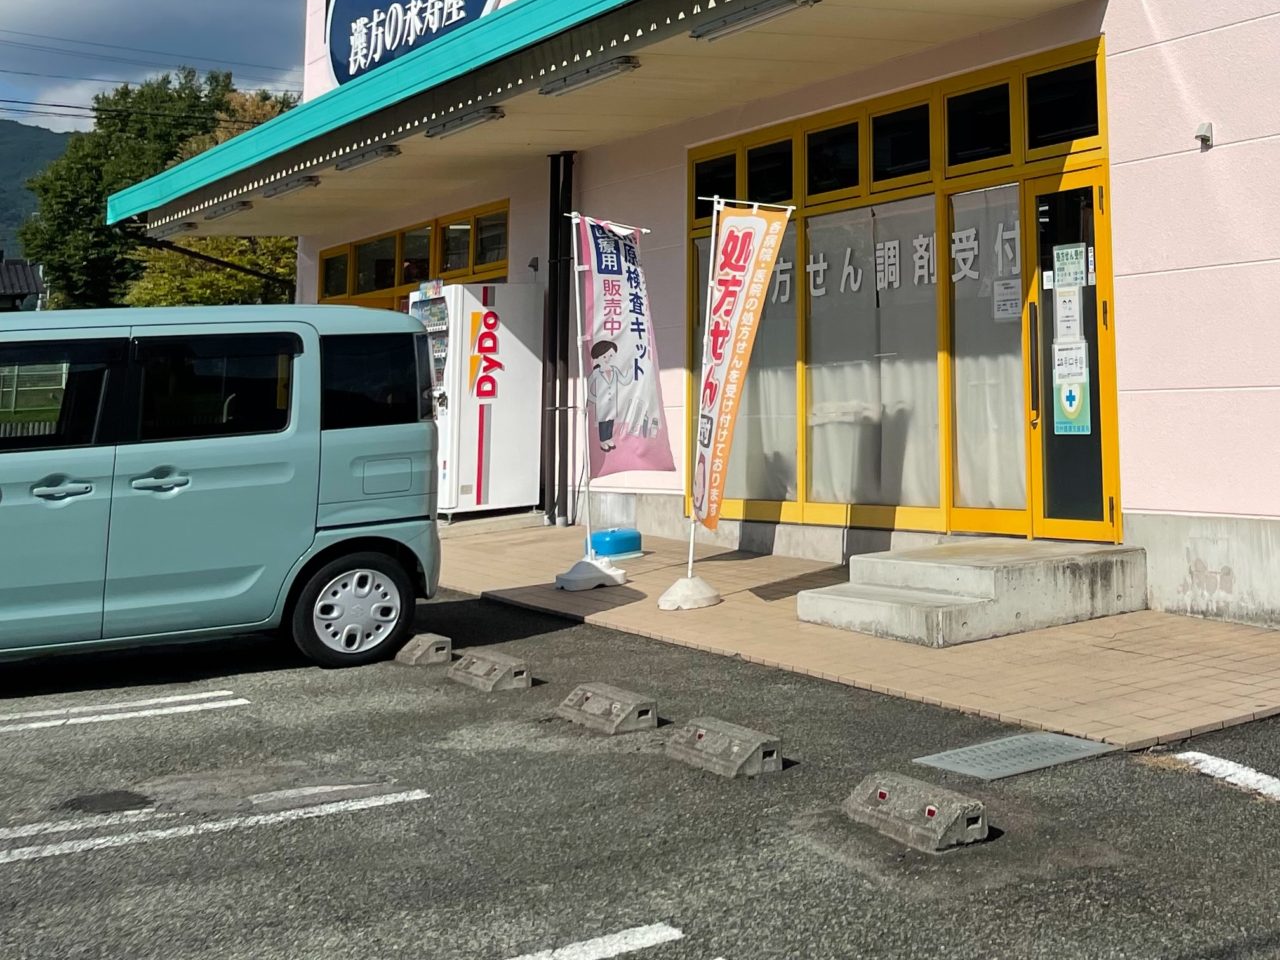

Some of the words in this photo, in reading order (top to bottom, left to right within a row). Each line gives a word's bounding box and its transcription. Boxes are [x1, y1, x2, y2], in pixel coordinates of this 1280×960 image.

[603, 279, 623, 336] 販売中
[702, 229, 754, 408] 処方せん
[476, 310, 505, 398] DyDo
